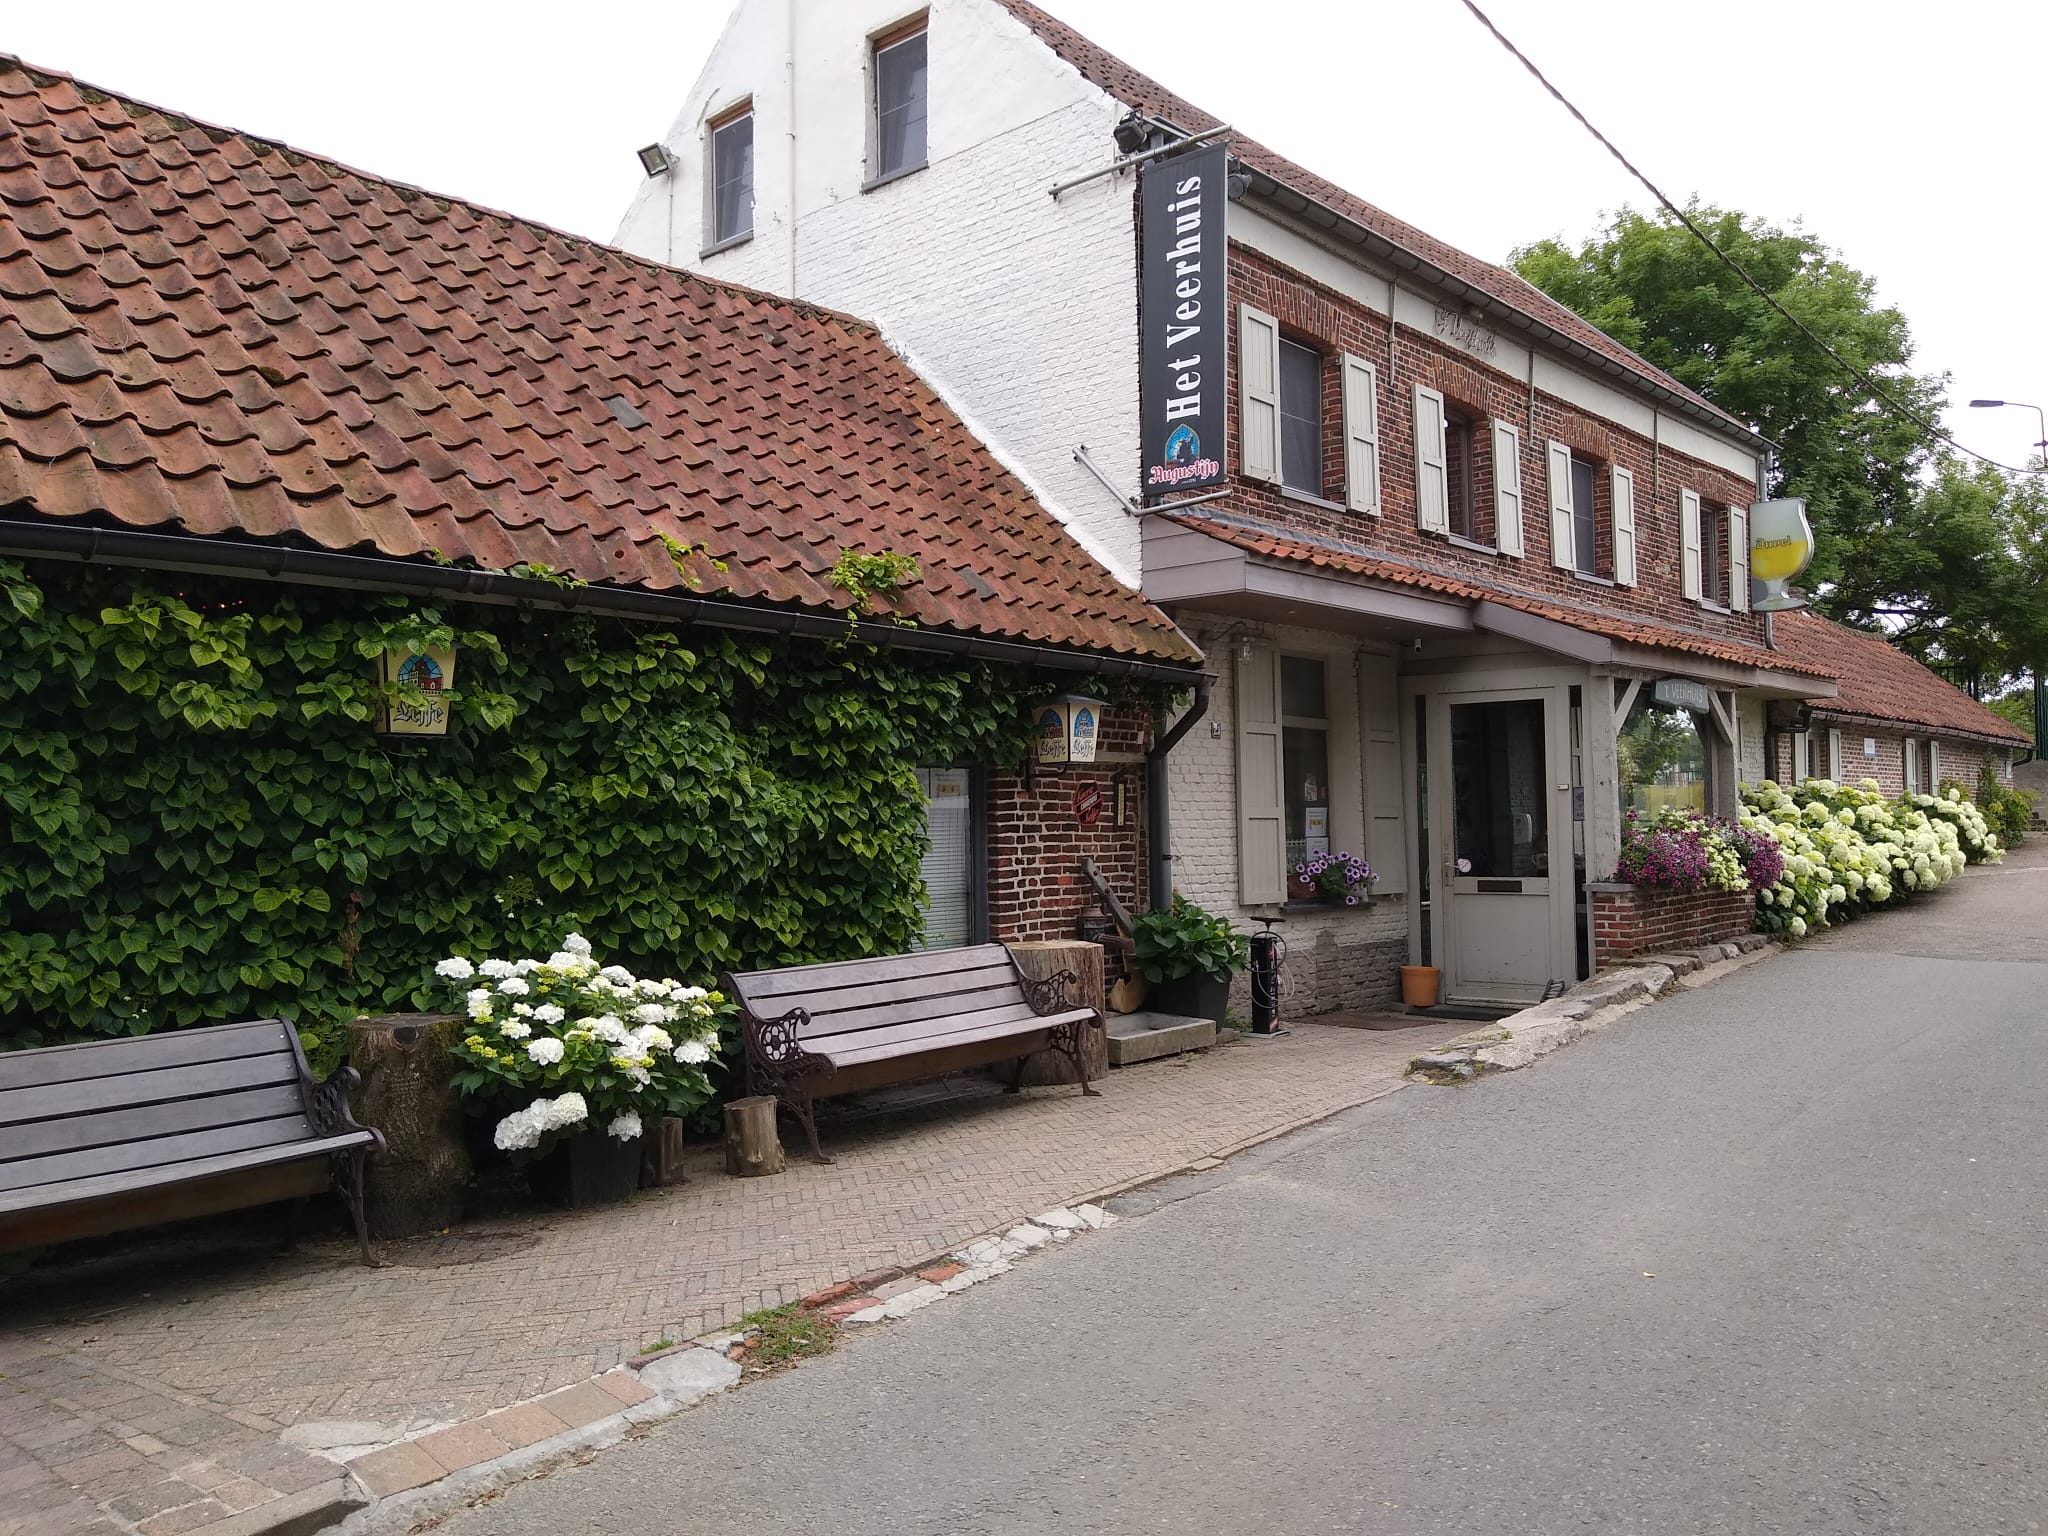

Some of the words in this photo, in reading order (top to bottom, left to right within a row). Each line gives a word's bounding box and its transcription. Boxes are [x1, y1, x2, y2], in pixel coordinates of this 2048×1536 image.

[1166, 175, 1202, 349] Veerhuis
[1166, 354, 1202, 423] Het
[1148, 457, 1220, 485] Augustijn
[1039, 740, 1067, 759] Leffe
[1071, 738, 1096, 758] Leffe
